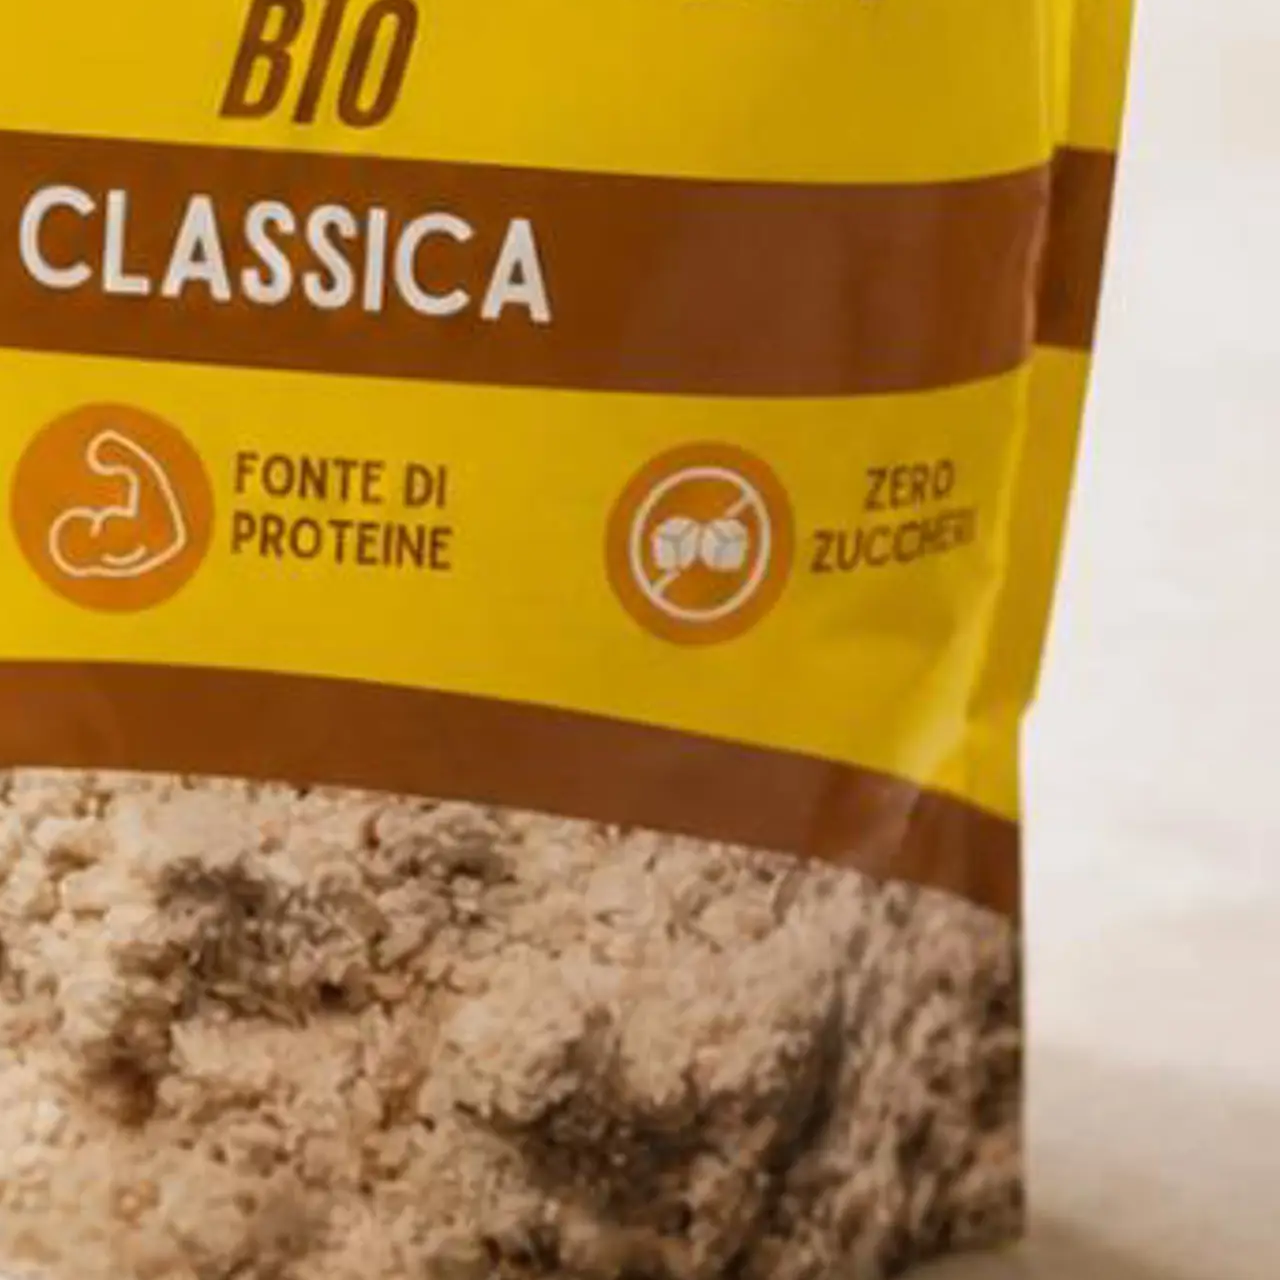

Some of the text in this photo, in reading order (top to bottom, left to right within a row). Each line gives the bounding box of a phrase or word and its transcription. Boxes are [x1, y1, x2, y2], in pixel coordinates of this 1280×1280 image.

[18, 184, 554, 324] CLASSICA
[235, 451, 447, 509] FONTE DI
[864, 457, 955, 512] ZERO
[231, 510, 453, 570] PROTEINE
[810, 507, 976, 574] ZUCCHE
